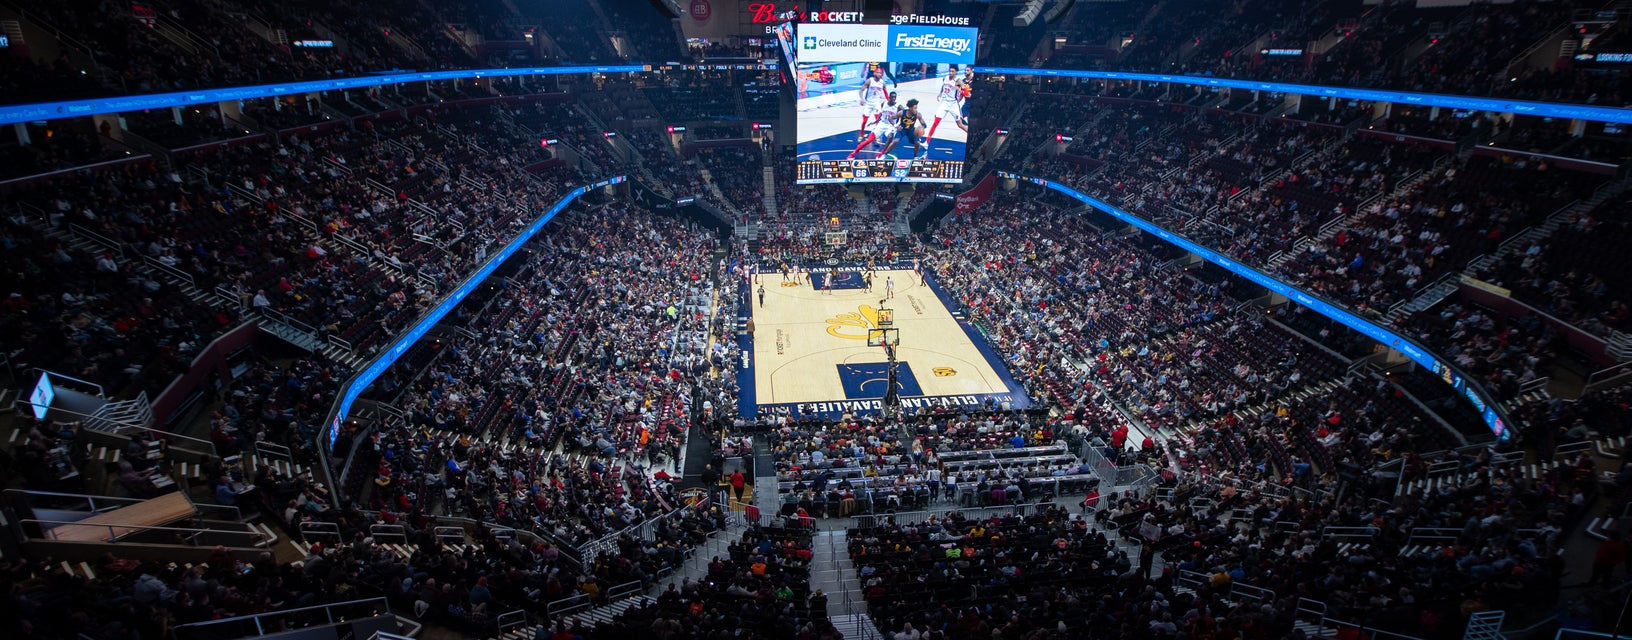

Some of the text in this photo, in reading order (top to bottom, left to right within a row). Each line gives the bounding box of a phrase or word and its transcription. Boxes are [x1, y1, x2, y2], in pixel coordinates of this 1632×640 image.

[811, 12, 858, 22] ROCKET
[909, 14, 969, 25] FIELDHOUSE
[818, 39, 857, 47] Cleveland
[896, 33, 971, 52] FirstEnergy
[856, 169, 867, 178] 66
[895, 169, 906, 177] 52
